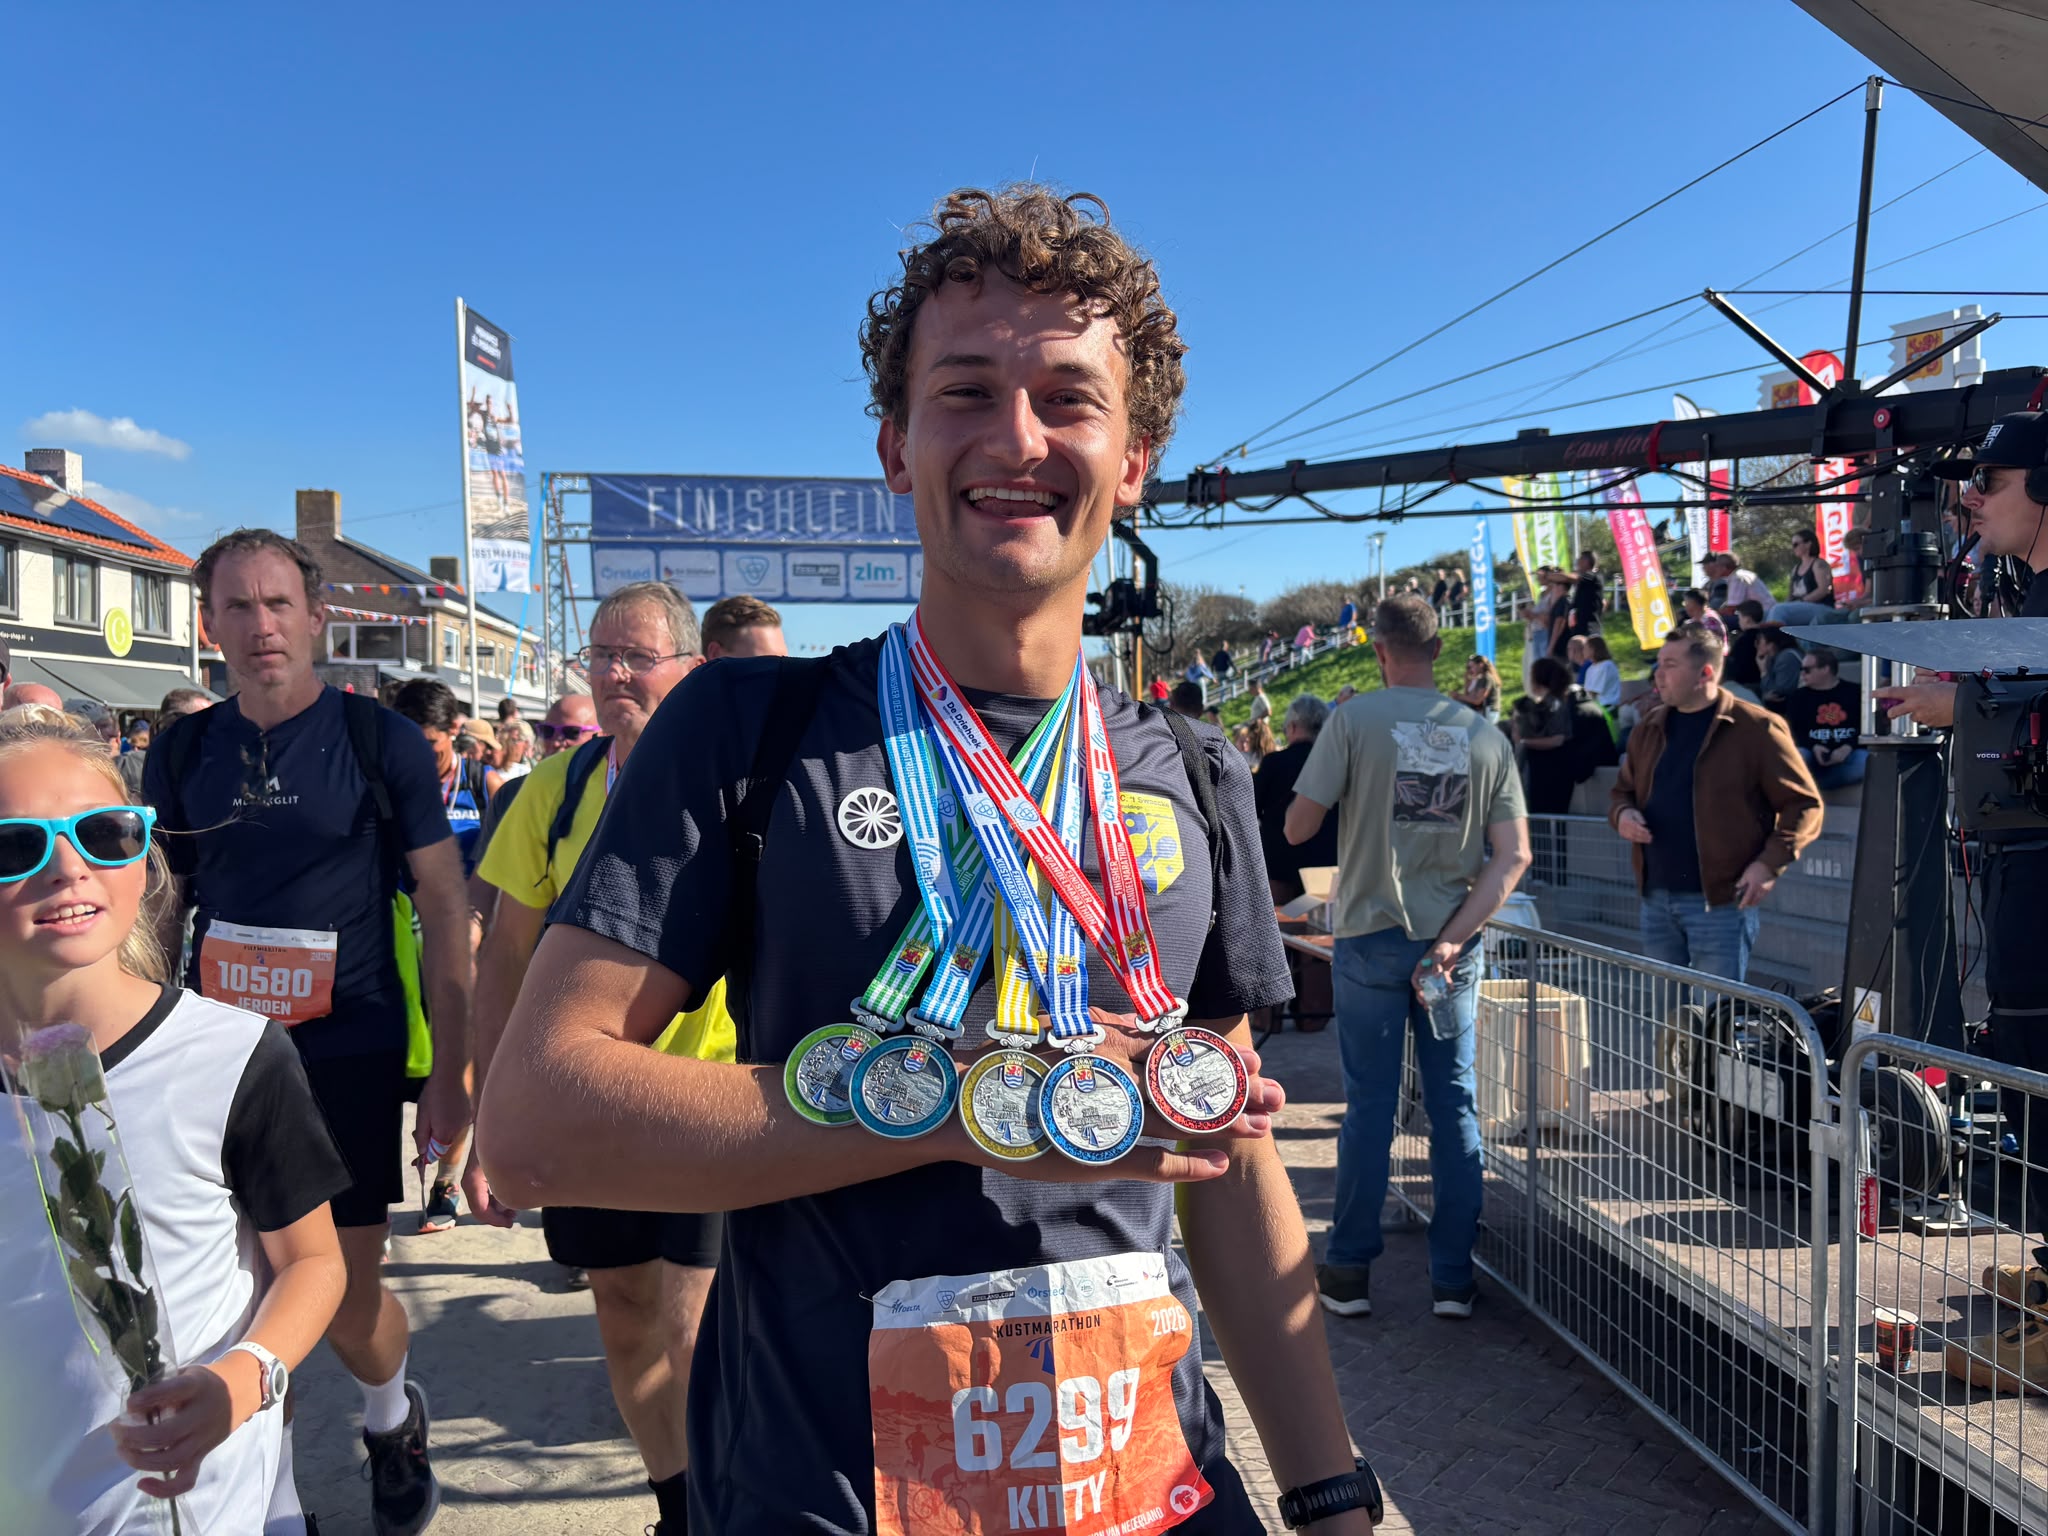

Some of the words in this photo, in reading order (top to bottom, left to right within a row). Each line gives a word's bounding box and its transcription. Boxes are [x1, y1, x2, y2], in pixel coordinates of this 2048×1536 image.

[946, 701, 957, 714] De
[955, 712, 982, 749] Driehoek
[994, 857, 1030, 921] KUSTMARATHON
[1012, 870, 1034, 908] FINISHER
[1043, 853, 1098, 926] WANDELMARATHON
[1066, 869, 1094, 904] FINISHER
[1110, 861, 1124, 897] FINISHER
[217, 960, 313, 998] 10580
[234, 997, 291, 1016] JEROEN
[902, 1304, 921, 1313] DELTA
[996, 1313, 1101, 1338] KUSTMARATHON
[1151, 1305, 1187, 1338] 2026
[951, 1367, 1140, 1472] 6299
[1007, 1469, 1108, 1530] KITTY
[1121, 1506, 1165, 1534] NEDERLAND
